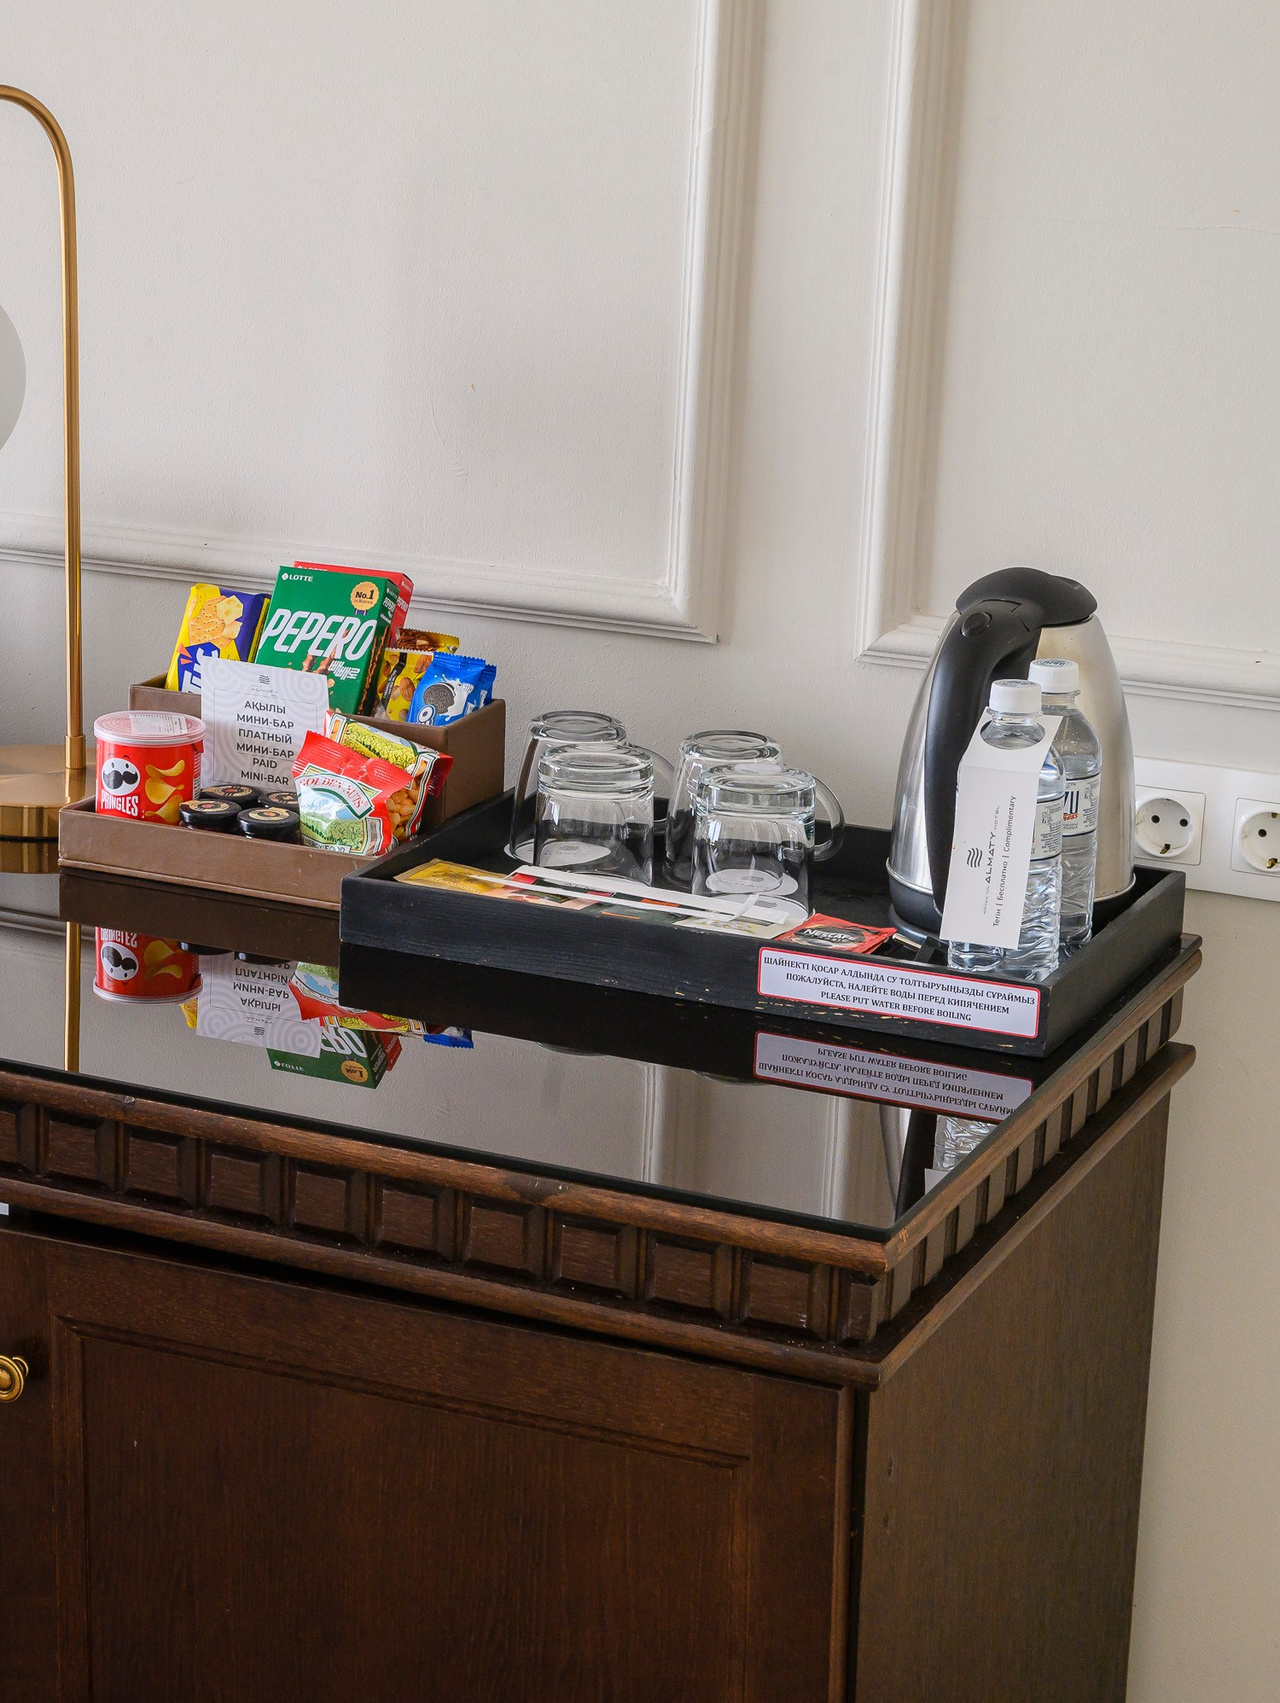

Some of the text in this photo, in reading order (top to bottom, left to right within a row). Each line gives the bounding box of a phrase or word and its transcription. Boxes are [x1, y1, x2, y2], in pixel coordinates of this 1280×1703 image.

[288, 574, 314, 582] LOTTE
[355, 590, 375, 600] No.1
[262, 608, 378, 660] PEPERO
[328, 660, 360, 680] 빼빼로
[244, 700, 286, 714] АҚЫЛЫ
[236, 714, 294, 729] МИНИ-БАР
[238, 728, 292, 744] ПЛАТНЫЙ
[236, 742, 294, 758] МИНИ-БАР
[252, 758, 278, 768] PAID
[240, 770, 289, 786] MINI-BAR
[100, 788, 139, 817] PRINGLES
[300, 777, 364, 808] GOLDEN NUTS
[984, 831, 997, 885] ALMATY
[993, 795, 1017, 927] Тегін Бесплатно Complimentary
[764, 956, 1035, 1005] ШАЙНЕКТІ ҚОСАР АЛДЫНДА СУ ТОЛТЫРУЫҢЫЗДЫ СҰРАЙМЫЗ
[786, 972, 1010, 1014] ПОЖАЛУЙСТА, НАЛЕЙТЕ ВОДЫ ПЕРЕД КИПЯЧЕНИЕМ
[820, 991, 972, 1021] PLEASE PUT WATER BEFORE BOILING
